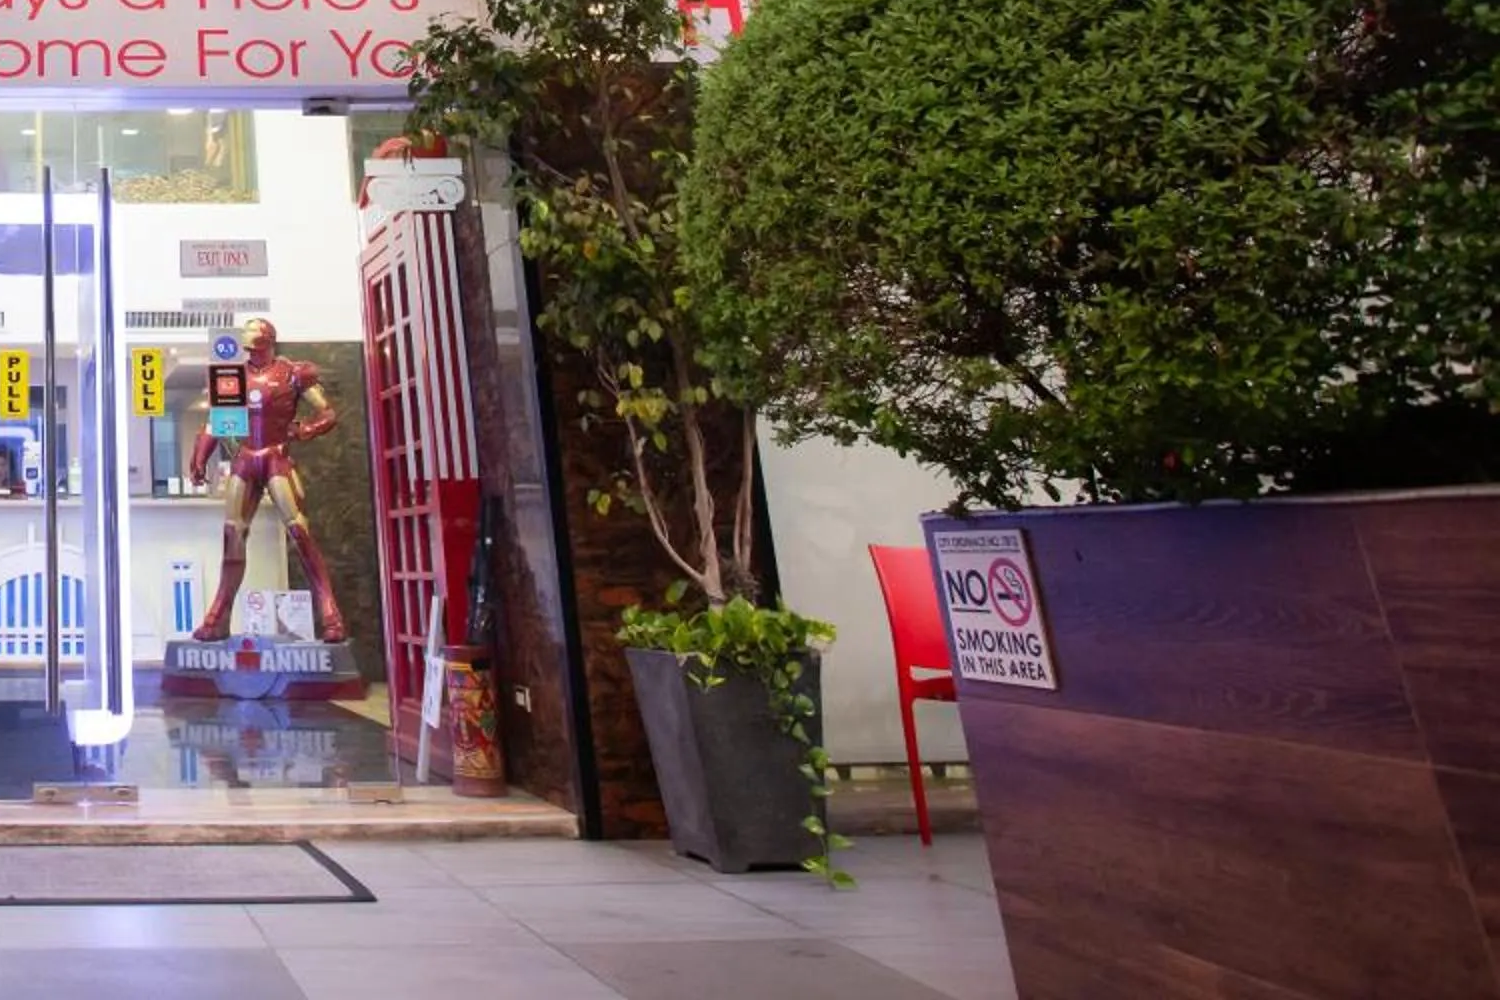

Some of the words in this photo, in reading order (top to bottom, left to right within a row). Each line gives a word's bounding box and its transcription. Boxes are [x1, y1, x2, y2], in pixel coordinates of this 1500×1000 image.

[198, 29, 307, 79] For
[329, 29, 442, 78] Yo
[7, 356, 21, 413] PULL
[141, 354, 155, 411] PULL
[945, 569, 988, 606] NO
[177, 647, 236, 671] IRON
[260, 649, 333, 672] ANNIE
[957, 629, 1042, 657] SMOKING
[962, 655, 975, 673] IN
[979, 657, 1005, 676] THIS
[1010, 660, 1047, 681] AREA
